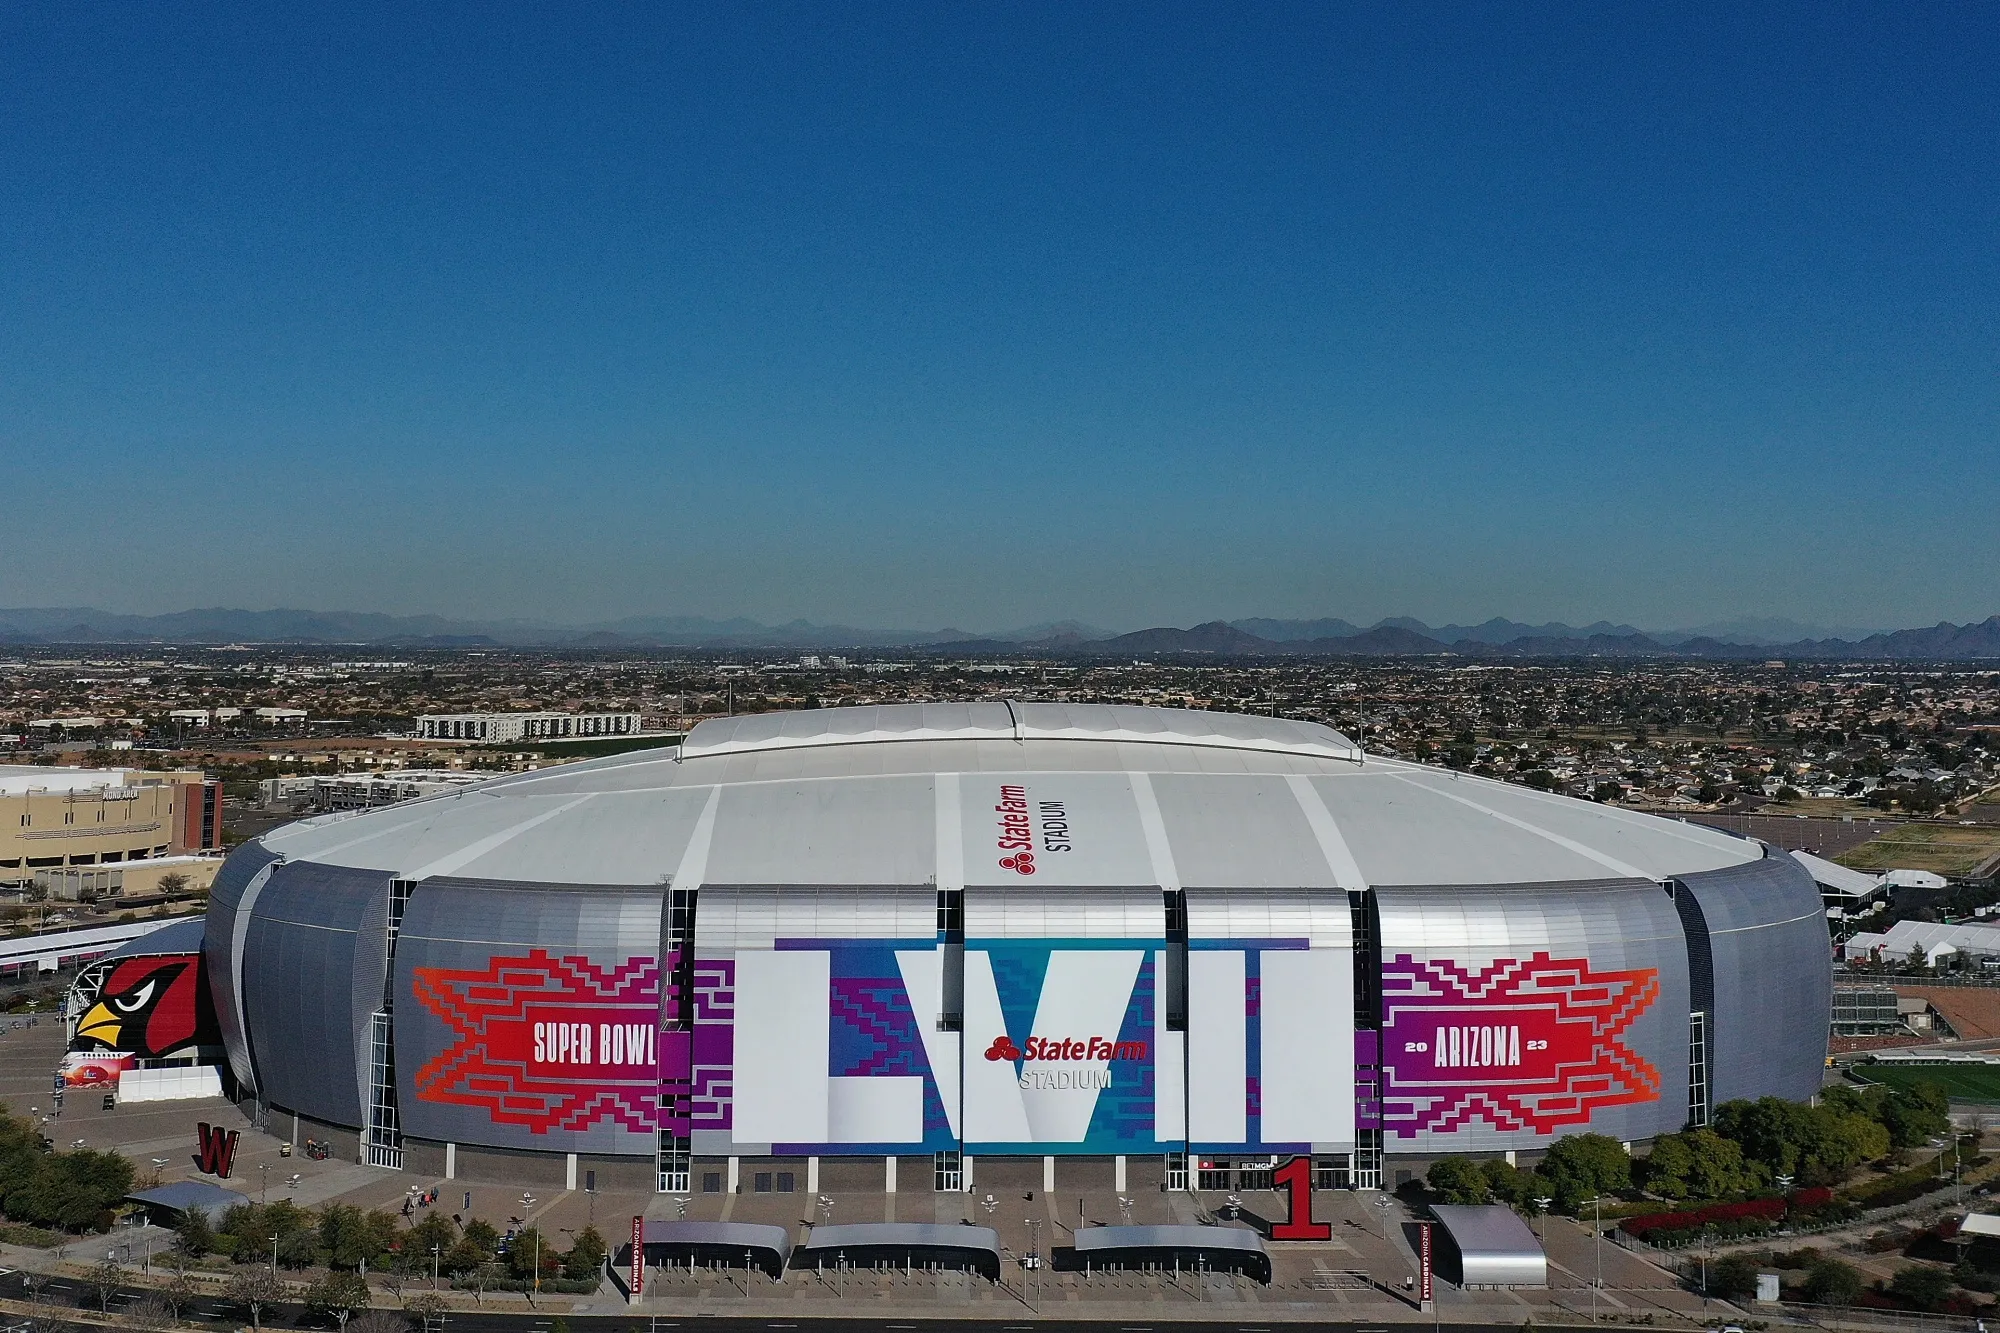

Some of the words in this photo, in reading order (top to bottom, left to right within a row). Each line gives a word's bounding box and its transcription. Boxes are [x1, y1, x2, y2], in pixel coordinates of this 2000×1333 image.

[1039, 801, 1072, 852] STADIUM
[534, 1022, 592, 1064] SUPER
[600, 1023, 657, 1065] BOWL
[1404, 1042, 1428, 1052] 20
[1434, 1026, 1521, 1067] ARIZONA
[1526, 1040, 1548, 1050] 23
[1019, 1069, 1112, 1089] STADIUM
[1270, 1154, 1332, 1241] 1
